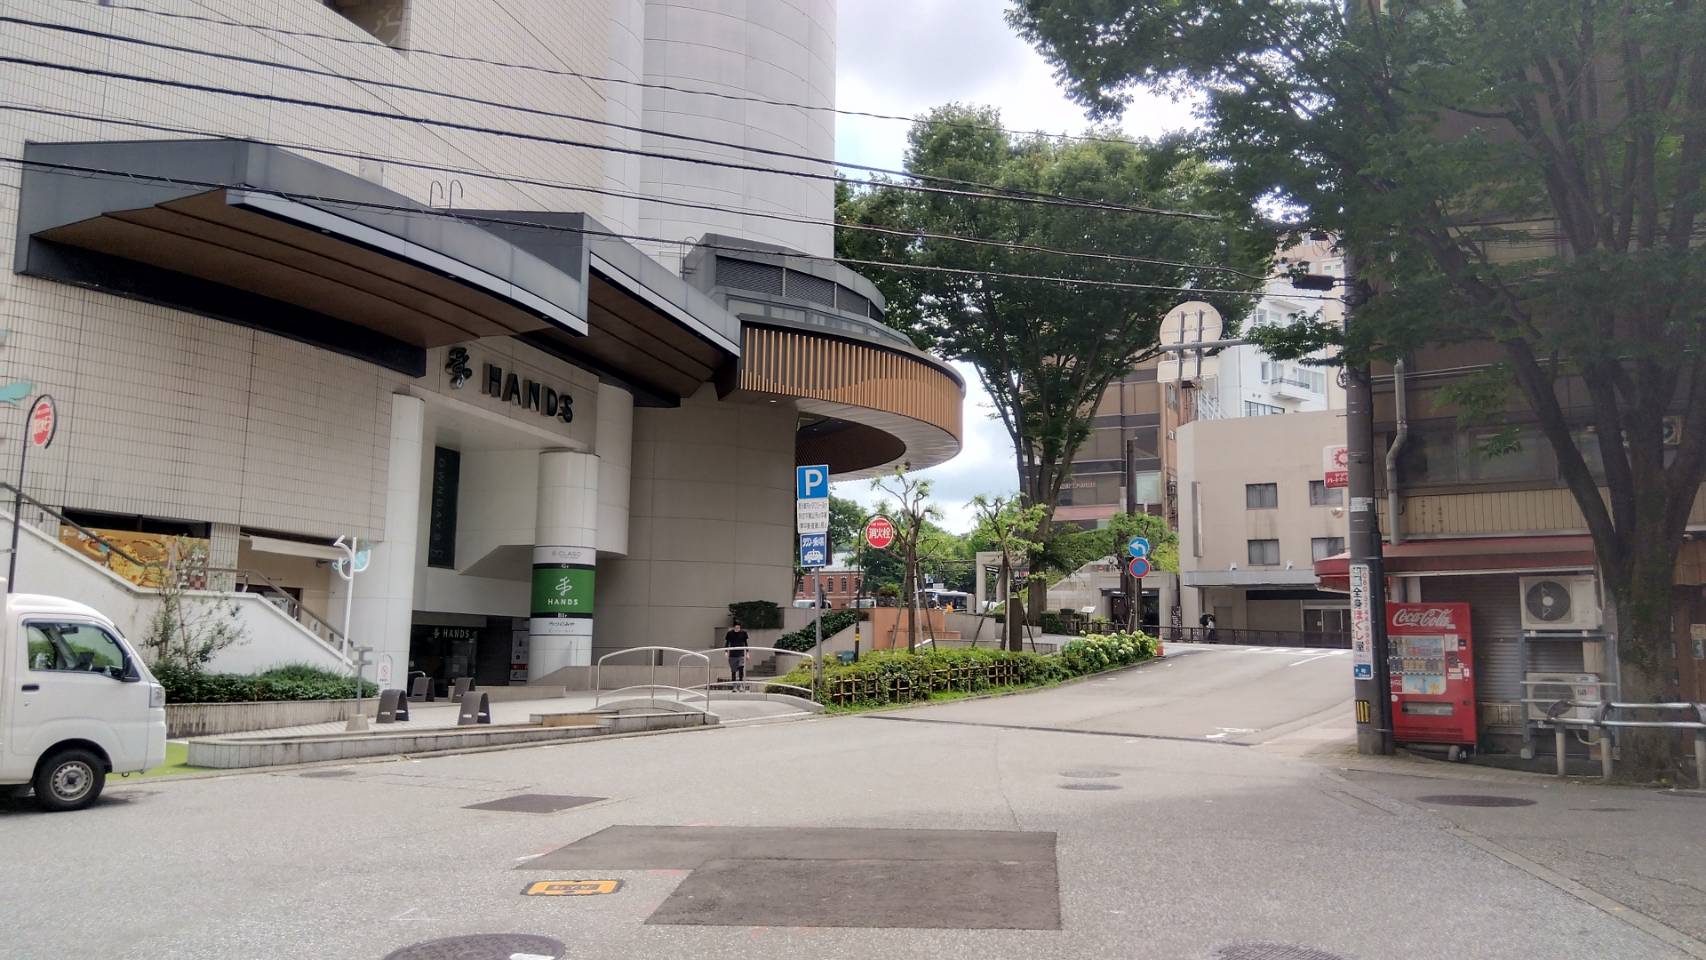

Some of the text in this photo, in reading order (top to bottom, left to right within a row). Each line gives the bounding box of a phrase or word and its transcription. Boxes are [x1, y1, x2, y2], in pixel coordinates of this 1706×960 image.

[483, 364, 574, 424] HANDS
[805, 469, 823, 496] P
[868, 528, 891, 539] 消火栓
[547, 598, 579, 606] HANDS
[1392, 608, 1453, 627] Coca-Cola
[443, 628, 470, 639] HANDS
